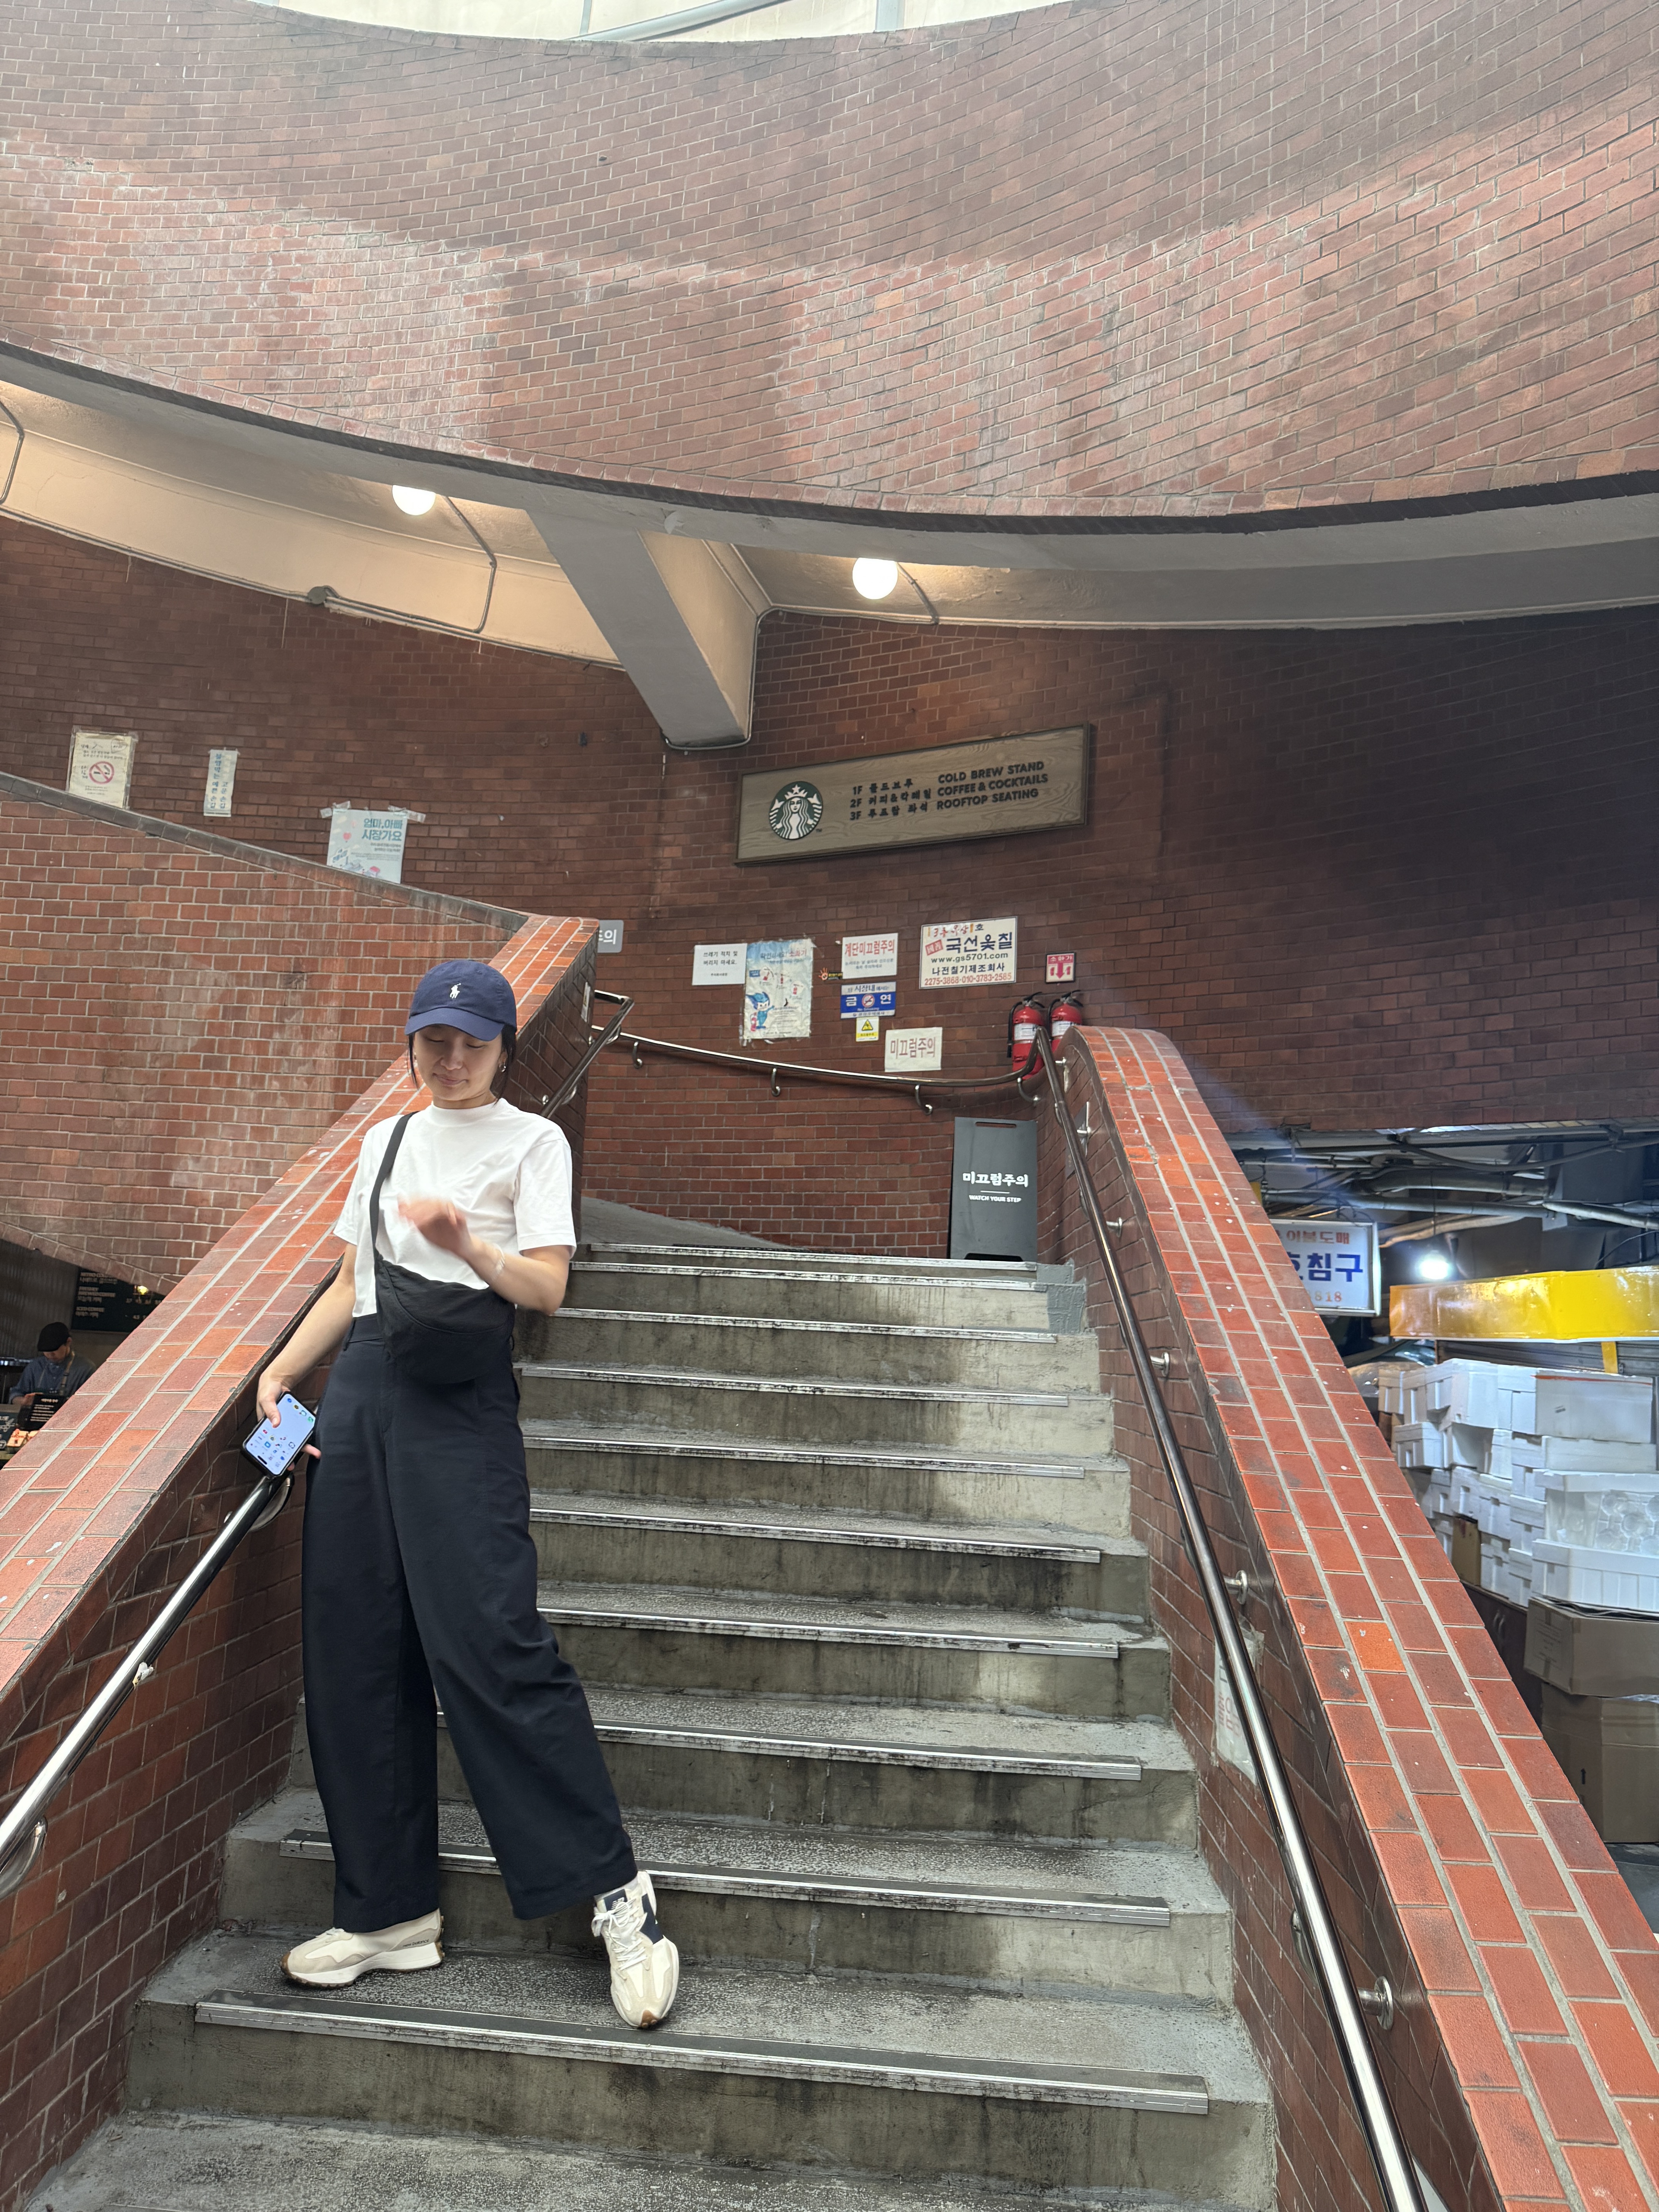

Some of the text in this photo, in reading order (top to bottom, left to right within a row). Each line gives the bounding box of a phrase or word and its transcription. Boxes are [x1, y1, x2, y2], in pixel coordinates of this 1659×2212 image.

[938, 761, 1044, 783] COLD BREW STAND
[853, 785, 863, 795] 1F
[937, 773, 1048, 796] COFFEE & COCKTAILS
[850, 798, 862, 808] 2F
[936, 788, 1039, 810] ROOFTOP SEATING
[850, 811, 862, 820] 3F
[362, 829, 402, 841] 시장가요
[845, 939, 895, 957] 계단미끄럼주의
[946, 932, 1012, 954] 국선옻칠
[931, 952, 1008, 963] www.gs5701.com
[932, 963, 1005, 975] 나전칠기제조회사
[854, 984, 875, 993] 시장내
[845, 994, 891, 1007] 금 연
[890, 1037, 936, 1059] 미끄럼주의
[963, 1171, 1028, 1188] 미끄럼주의
[1286, 1230, 1350, 1244] 이불도매
